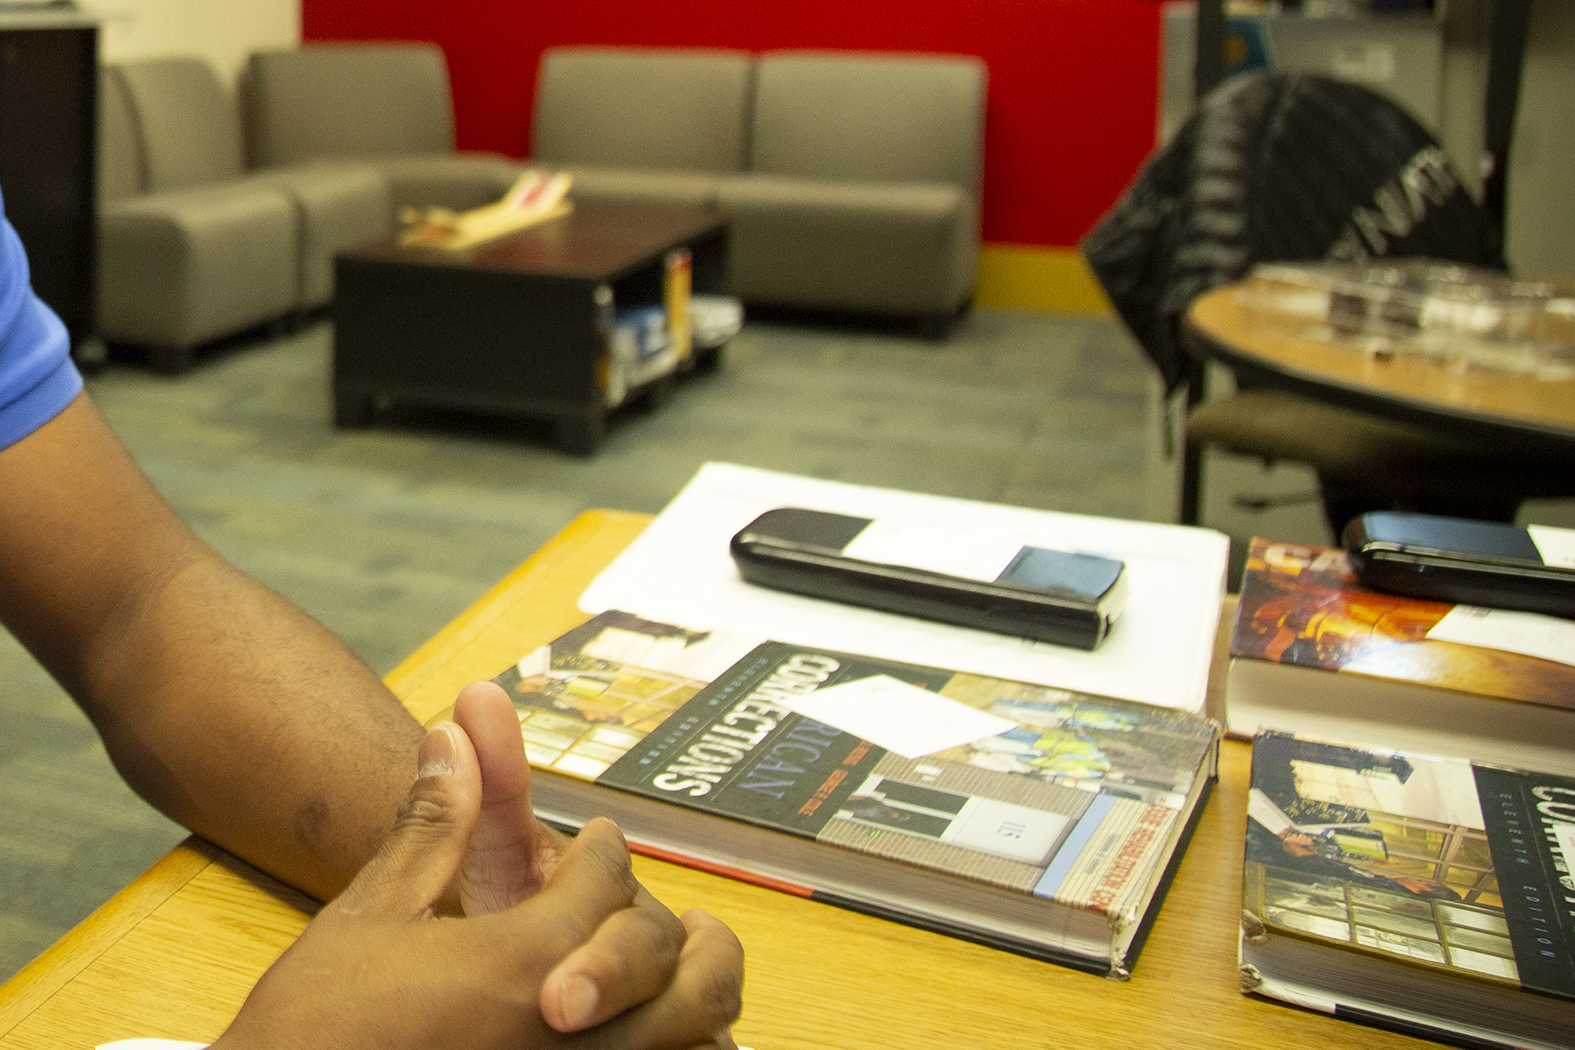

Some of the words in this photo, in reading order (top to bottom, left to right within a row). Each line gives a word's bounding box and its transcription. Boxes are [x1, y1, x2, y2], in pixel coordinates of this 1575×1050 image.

[651, 653, 841, 797] CORRECTIONS
[1499, 792, 1530, 865] ELEVENTH
[1523, 885, 1556, 959] EDITION
